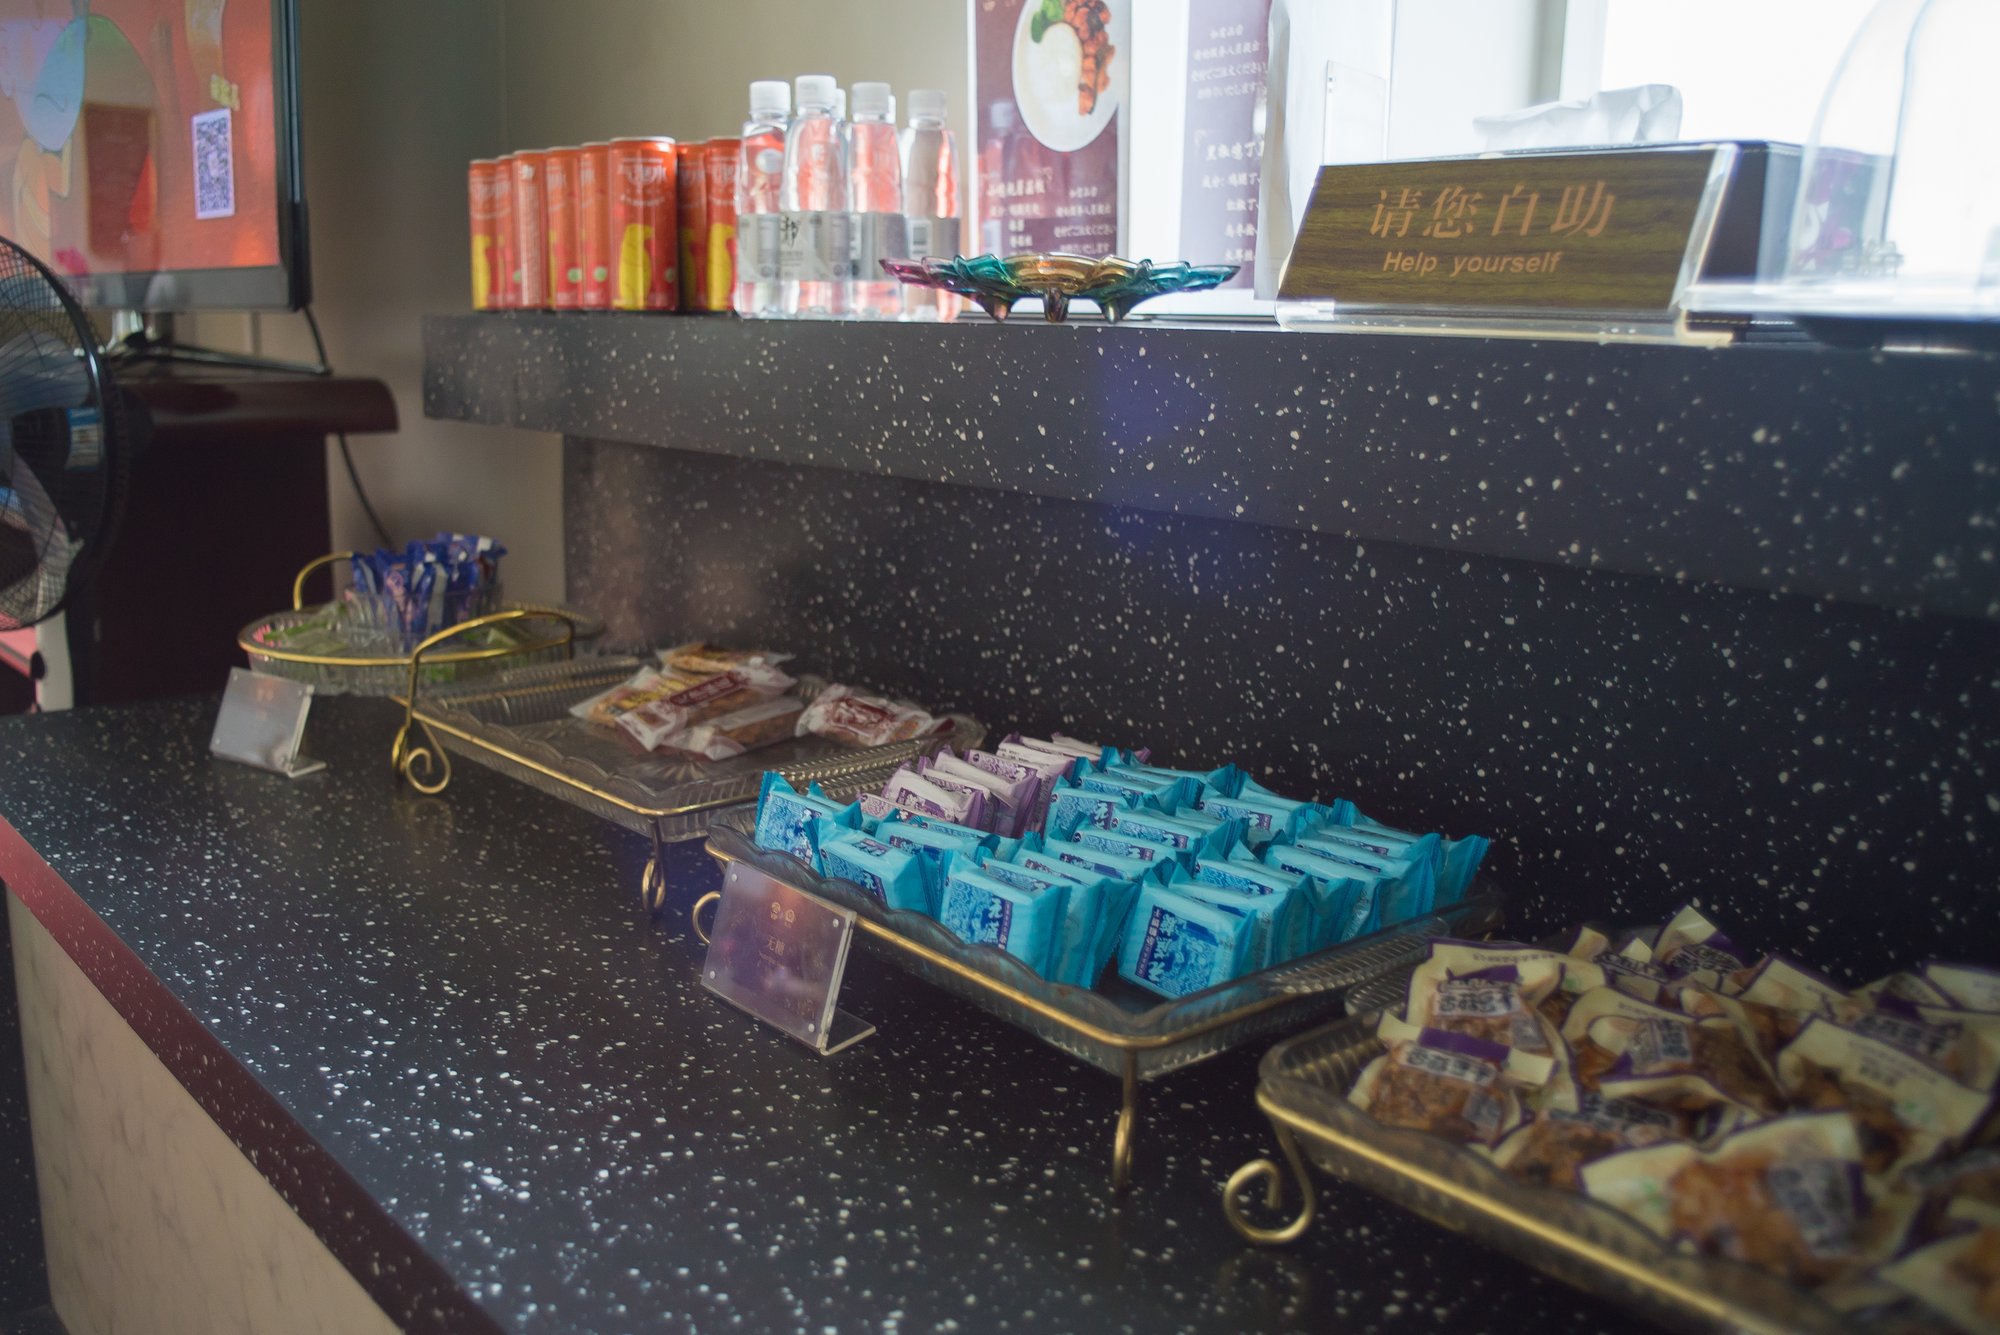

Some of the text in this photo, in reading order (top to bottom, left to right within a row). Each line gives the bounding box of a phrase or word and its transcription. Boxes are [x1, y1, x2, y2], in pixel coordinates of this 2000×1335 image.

[1368, 180, 1616, 239] 请您自助
[1383, 251, 1564, 277] Help yourself
